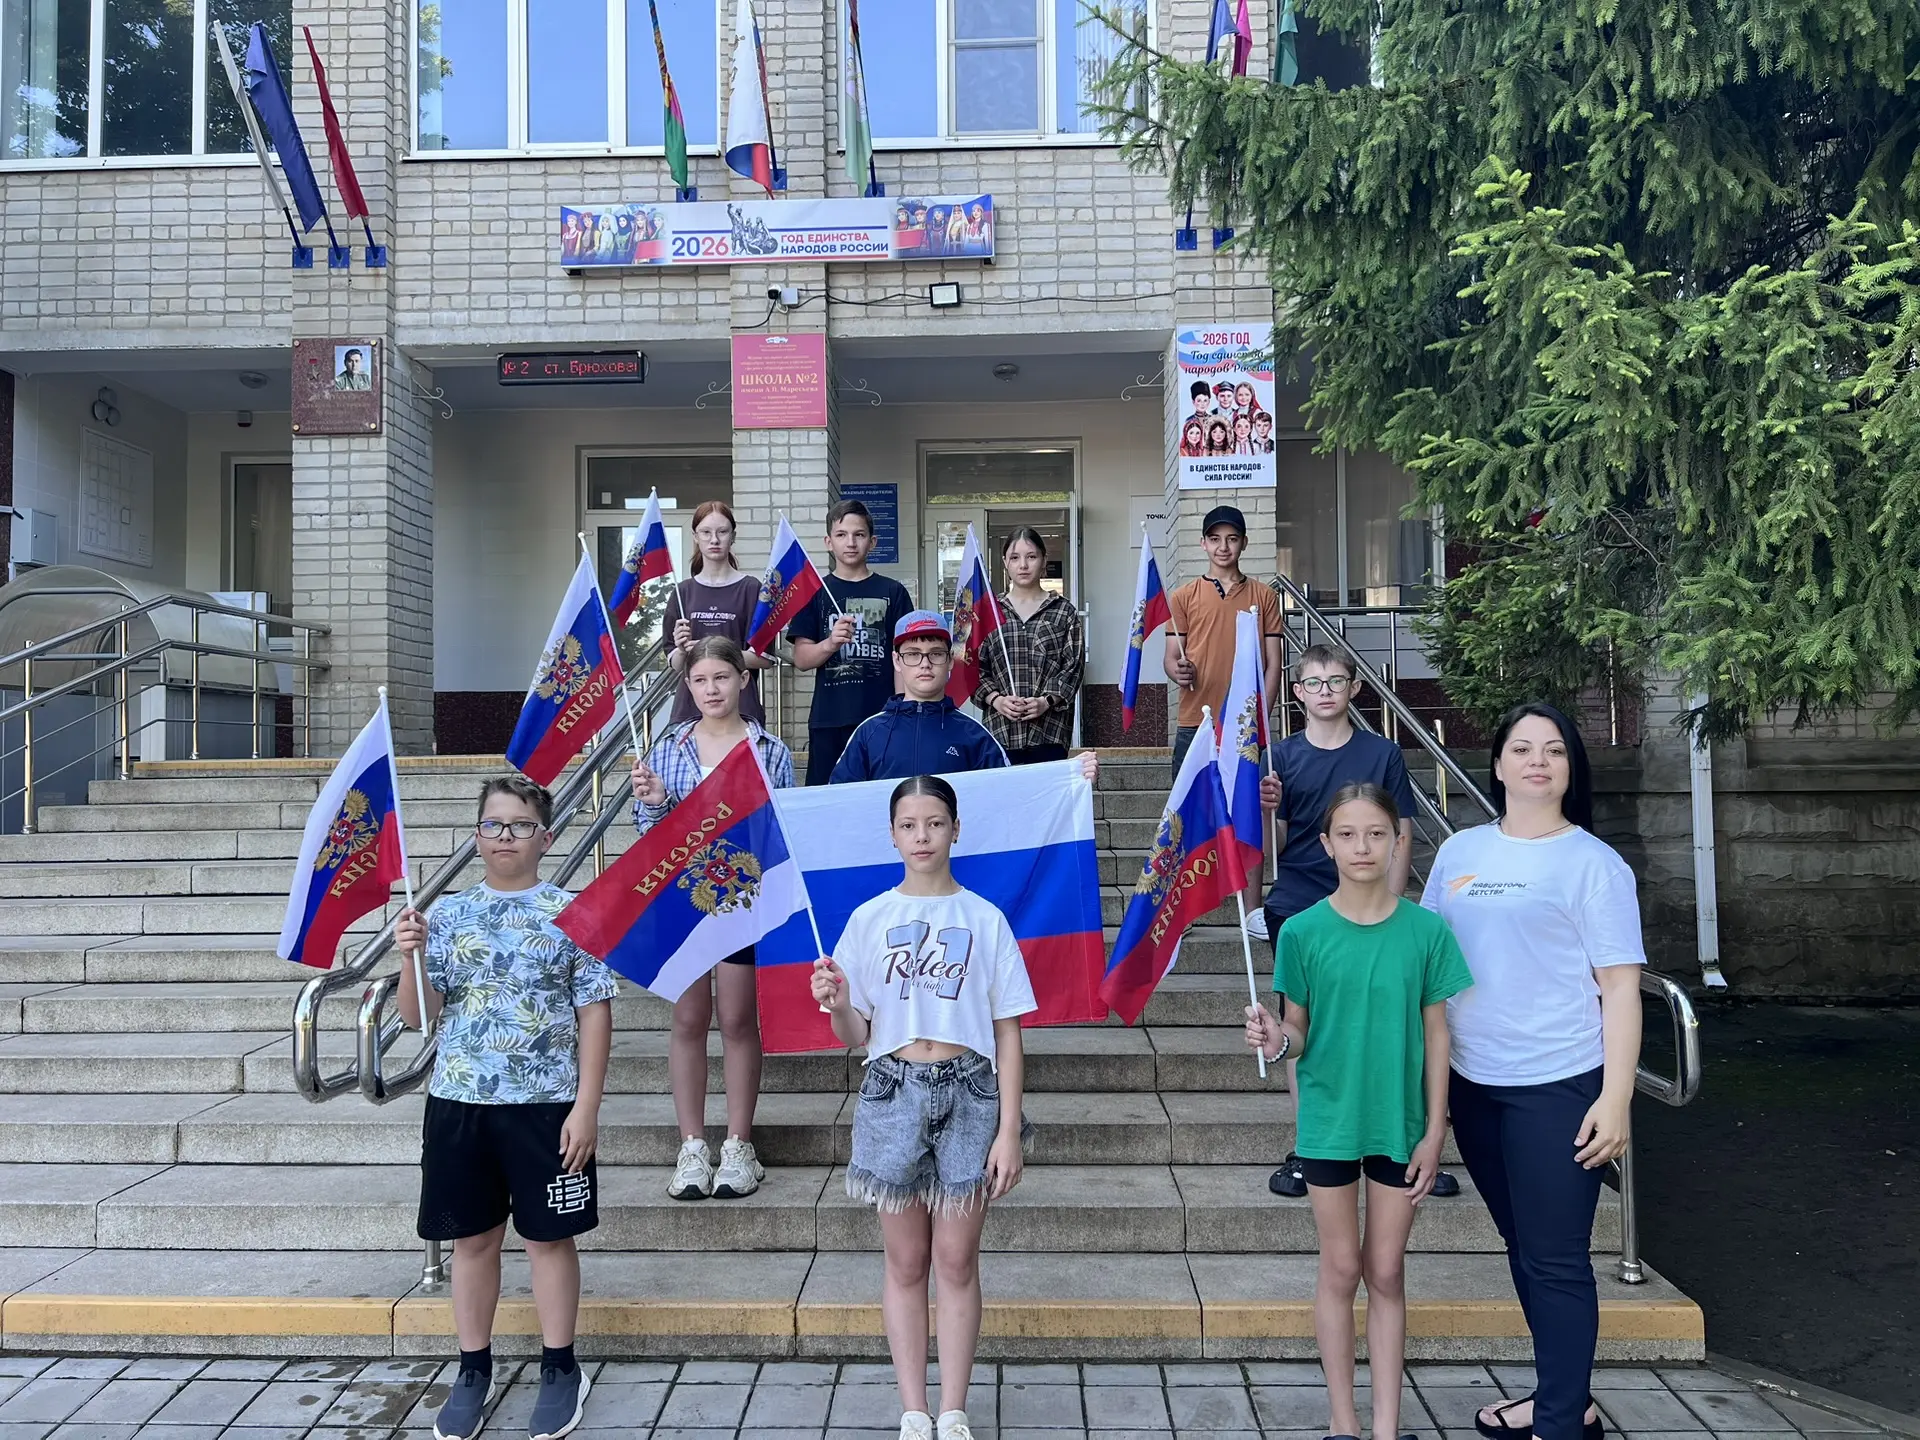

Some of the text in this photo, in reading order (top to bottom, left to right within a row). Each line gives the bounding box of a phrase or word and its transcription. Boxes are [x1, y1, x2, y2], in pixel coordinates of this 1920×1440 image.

[780, 232, 870, 244] ГОД ЕДИНСТВА
[672, 236, 729, 256] 2026
[780, 242, 889, 254] НАРОДОВ РОССИИ
[1203, 332, 1250, 345] 2026 ГОД
[1191, 350, 1209, 363] Год
[521, 361, 530, 374] 2
[544, 363, 565, 375] ст.
[1184, 362, 1230, 377] народов
[741, 372, 818, 385] ШКОЛА №2
[1195, 464, 1229, 472] ЕДИНСТВЕ
[1230, 463, 1262, 471] НАРОДОВ
[1223, 473, 1252, 481] РОССИИ!
[846, 643, 885, 658] VIBES
[632, 801, 733, 896] РОССИЯ
